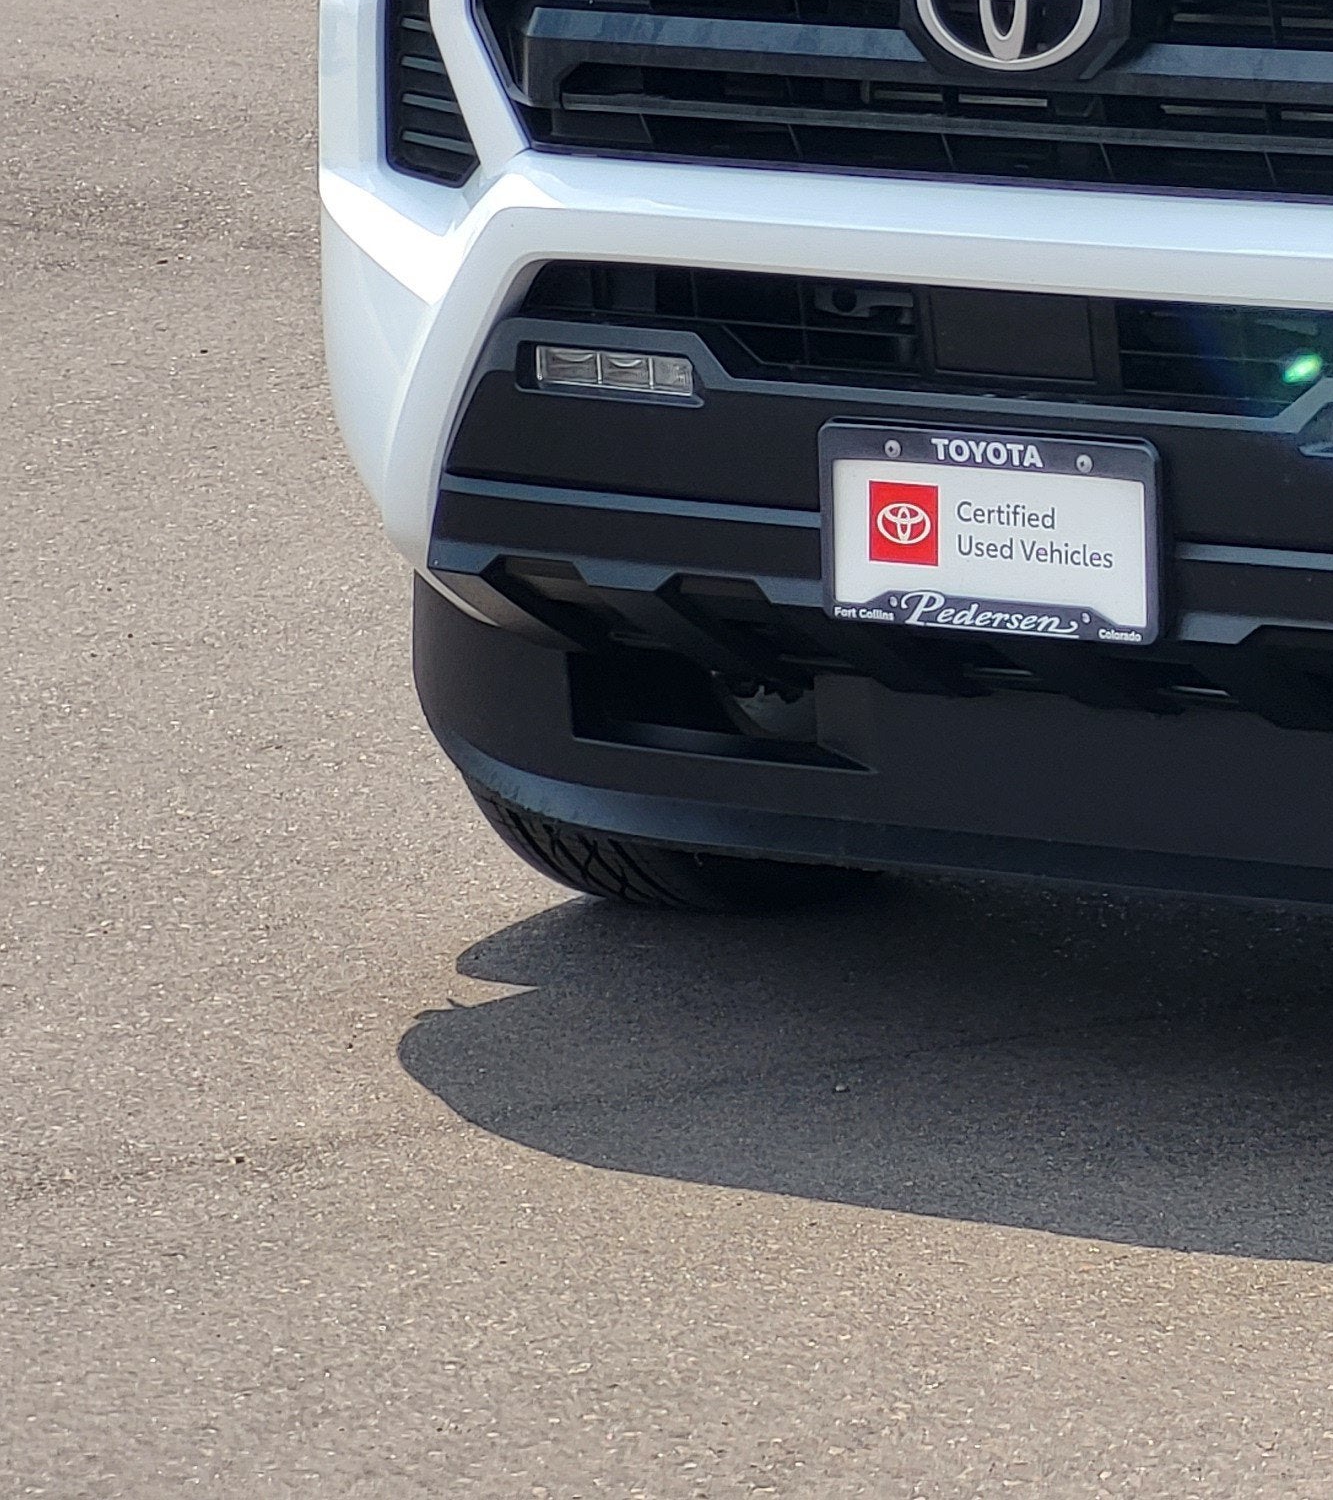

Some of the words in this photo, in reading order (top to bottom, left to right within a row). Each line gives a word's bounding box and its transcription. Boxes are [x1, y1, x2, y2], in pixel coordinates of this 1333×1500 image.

[931, 437, 1044, 468] TOYOTA
[957, 500, 1056, 530] Certified
[957, 534, 1014, 561] Used
[1020, 539, 1114, 569] Vehicles
[834, 605, 858, 619] Fort
[859, 607, 895, 621] Collins
[900, 590, 1080, 638] Pedersen
[1098, 628, 1142, 643] Colorado
